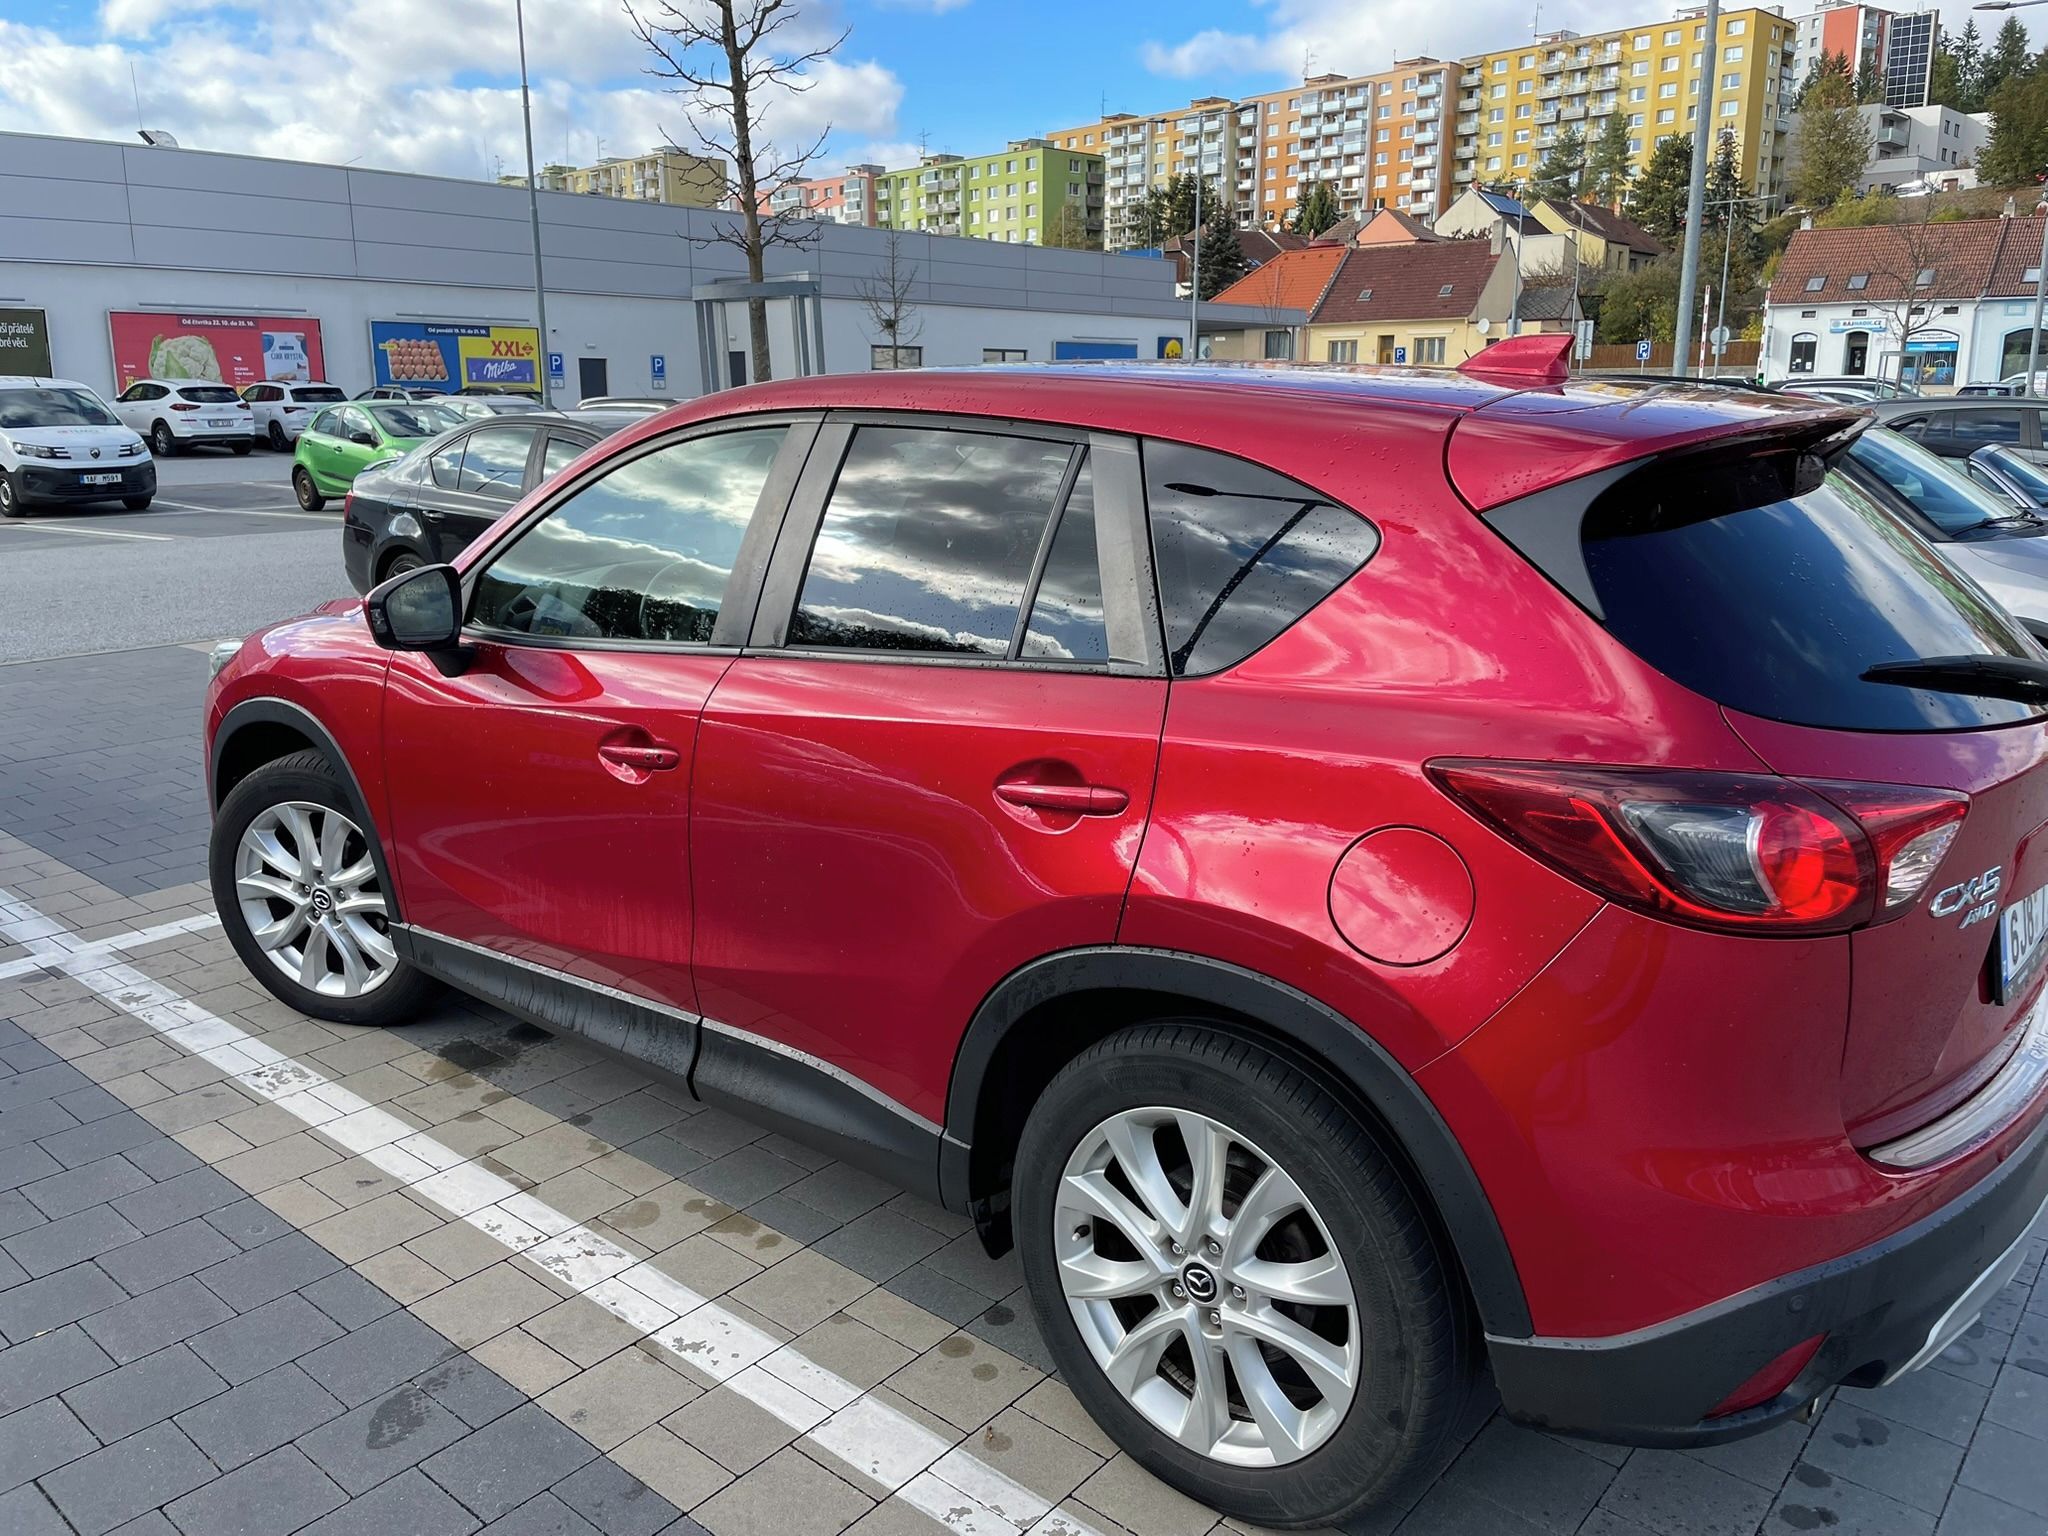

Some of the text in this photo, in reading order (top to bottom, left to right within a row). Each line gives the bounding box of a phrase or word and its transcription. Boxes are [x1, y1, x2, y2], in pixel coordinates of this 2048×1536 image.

[8, 322, 34, 336] přátelé
[12, 337, 28, 348] věci.
[491, 340, 525, 357] XXL
[1639, 343, 1648, 354] P
[1396, 348, 1404, 359] P
[483, 360, 517, 379] Milka
[552, 355, 561, 370] P
[654, 358, 663, 372] P
[1929, 865, 2002, 918] CX-5
[1959, 900, 1997, 929] AWD
